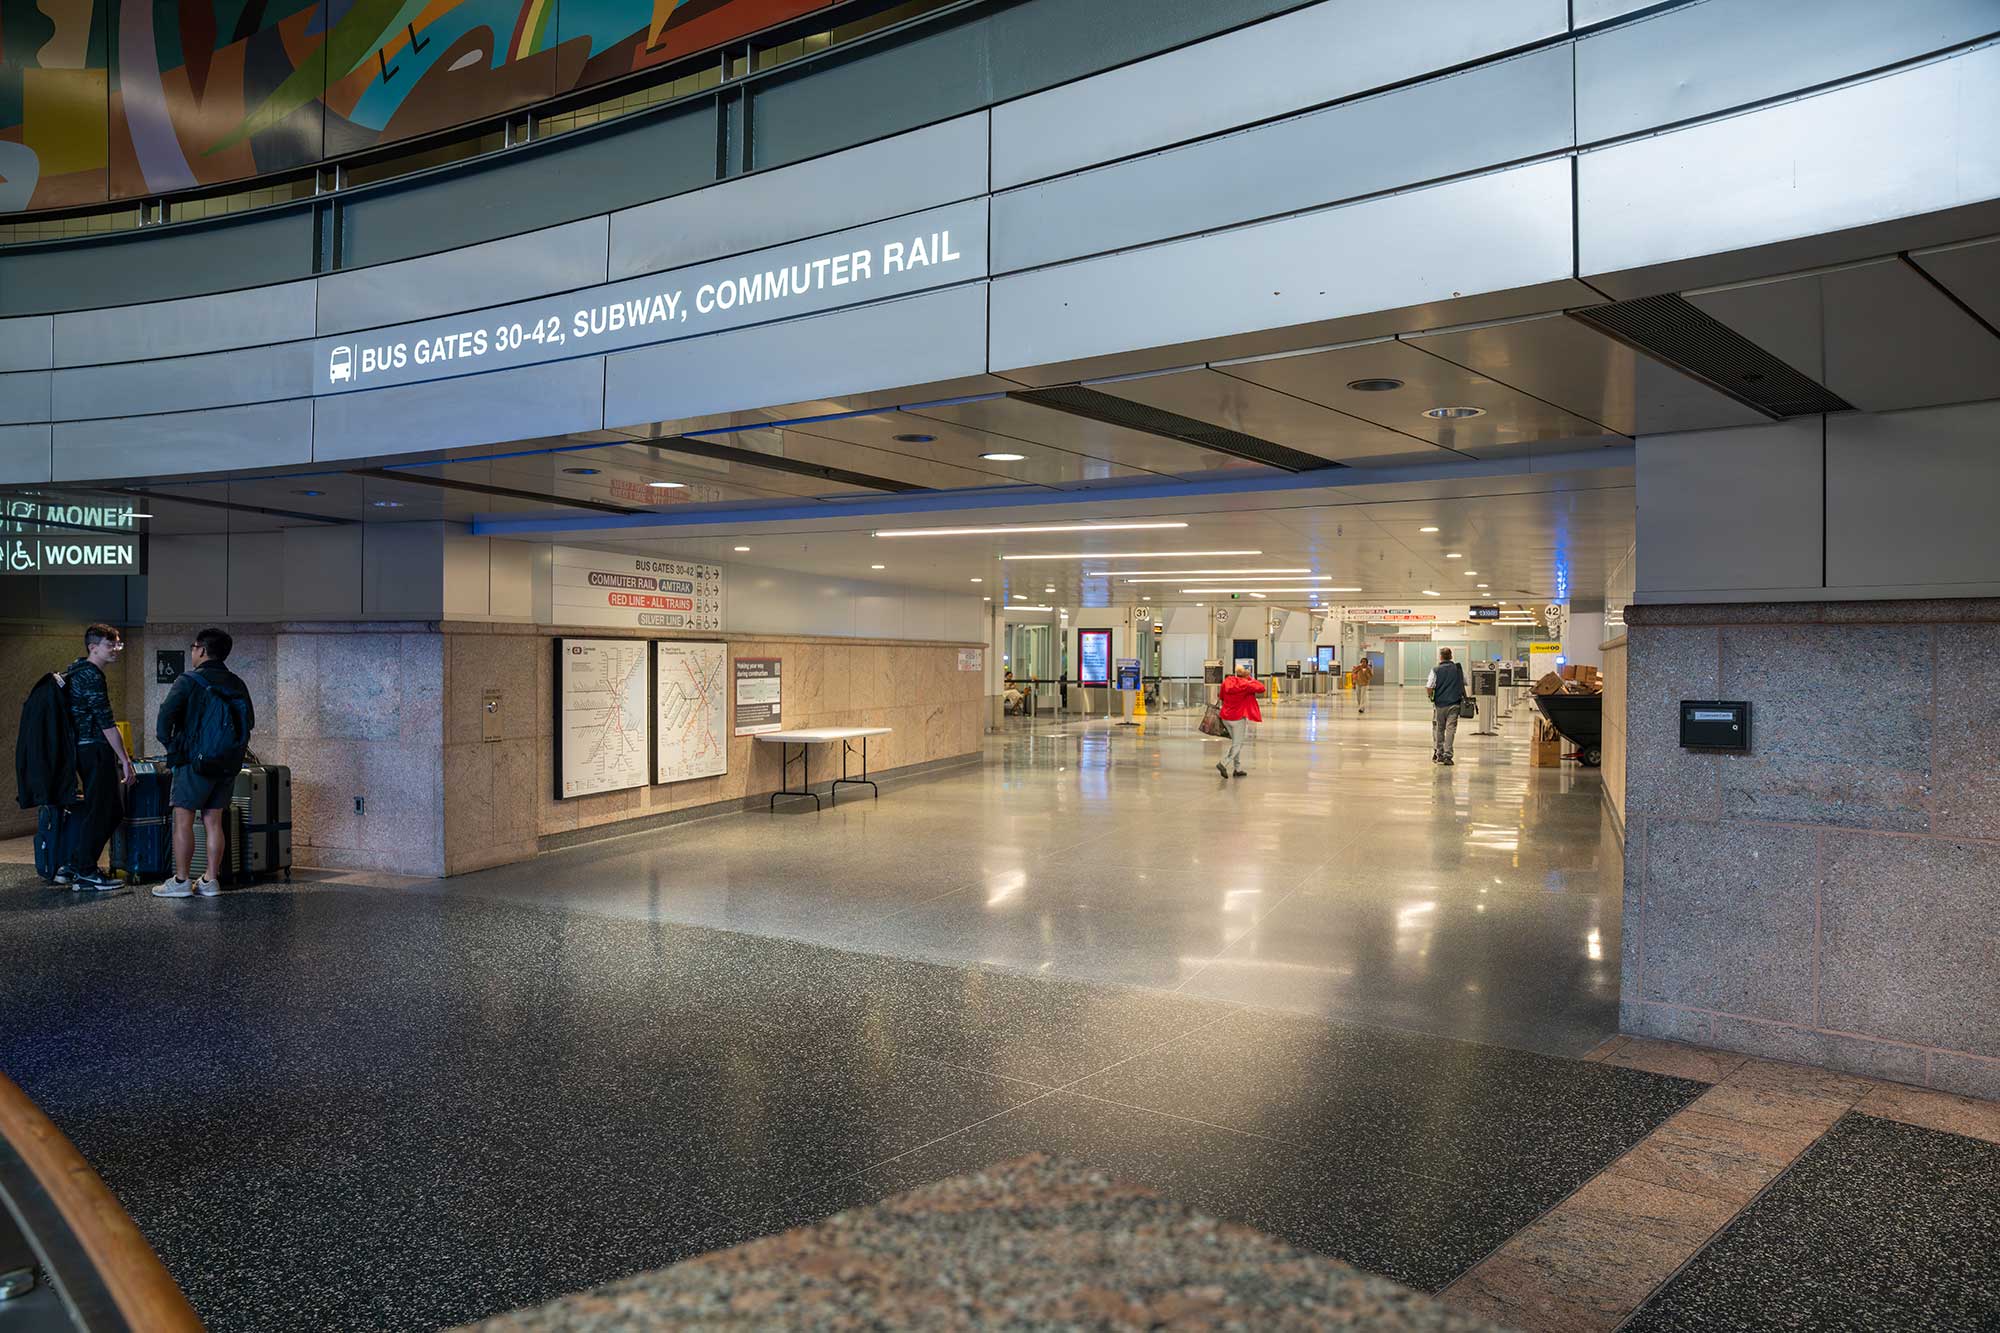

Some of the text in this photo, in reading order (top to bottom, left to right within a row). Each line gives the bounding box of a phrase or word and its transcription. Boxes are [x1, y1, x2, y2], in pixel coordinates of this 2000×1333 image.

[362, 230, 961, 373] BUS GATES 30-42, SUBWAY, COMMUTER RAIL
[45, 545, 133, 565] WOMEN
[635, 560, 694, 577] BUS GATES 30-42
[591, 573, 655, 590] COMMUTER RAIL
[661, 581, 691, 593] AMTRAK
[611, 594, 626, 605] RED
[628, 595, 645, 606] LINE
[651, 598, 664, 608] ALL
[666, 599, 691, 610] TRAINS
[1136, 608, 1147, 618] 31
[1545, 607, 1559, 616] 42
[640, 614, 682, 626] SILVER LINE
